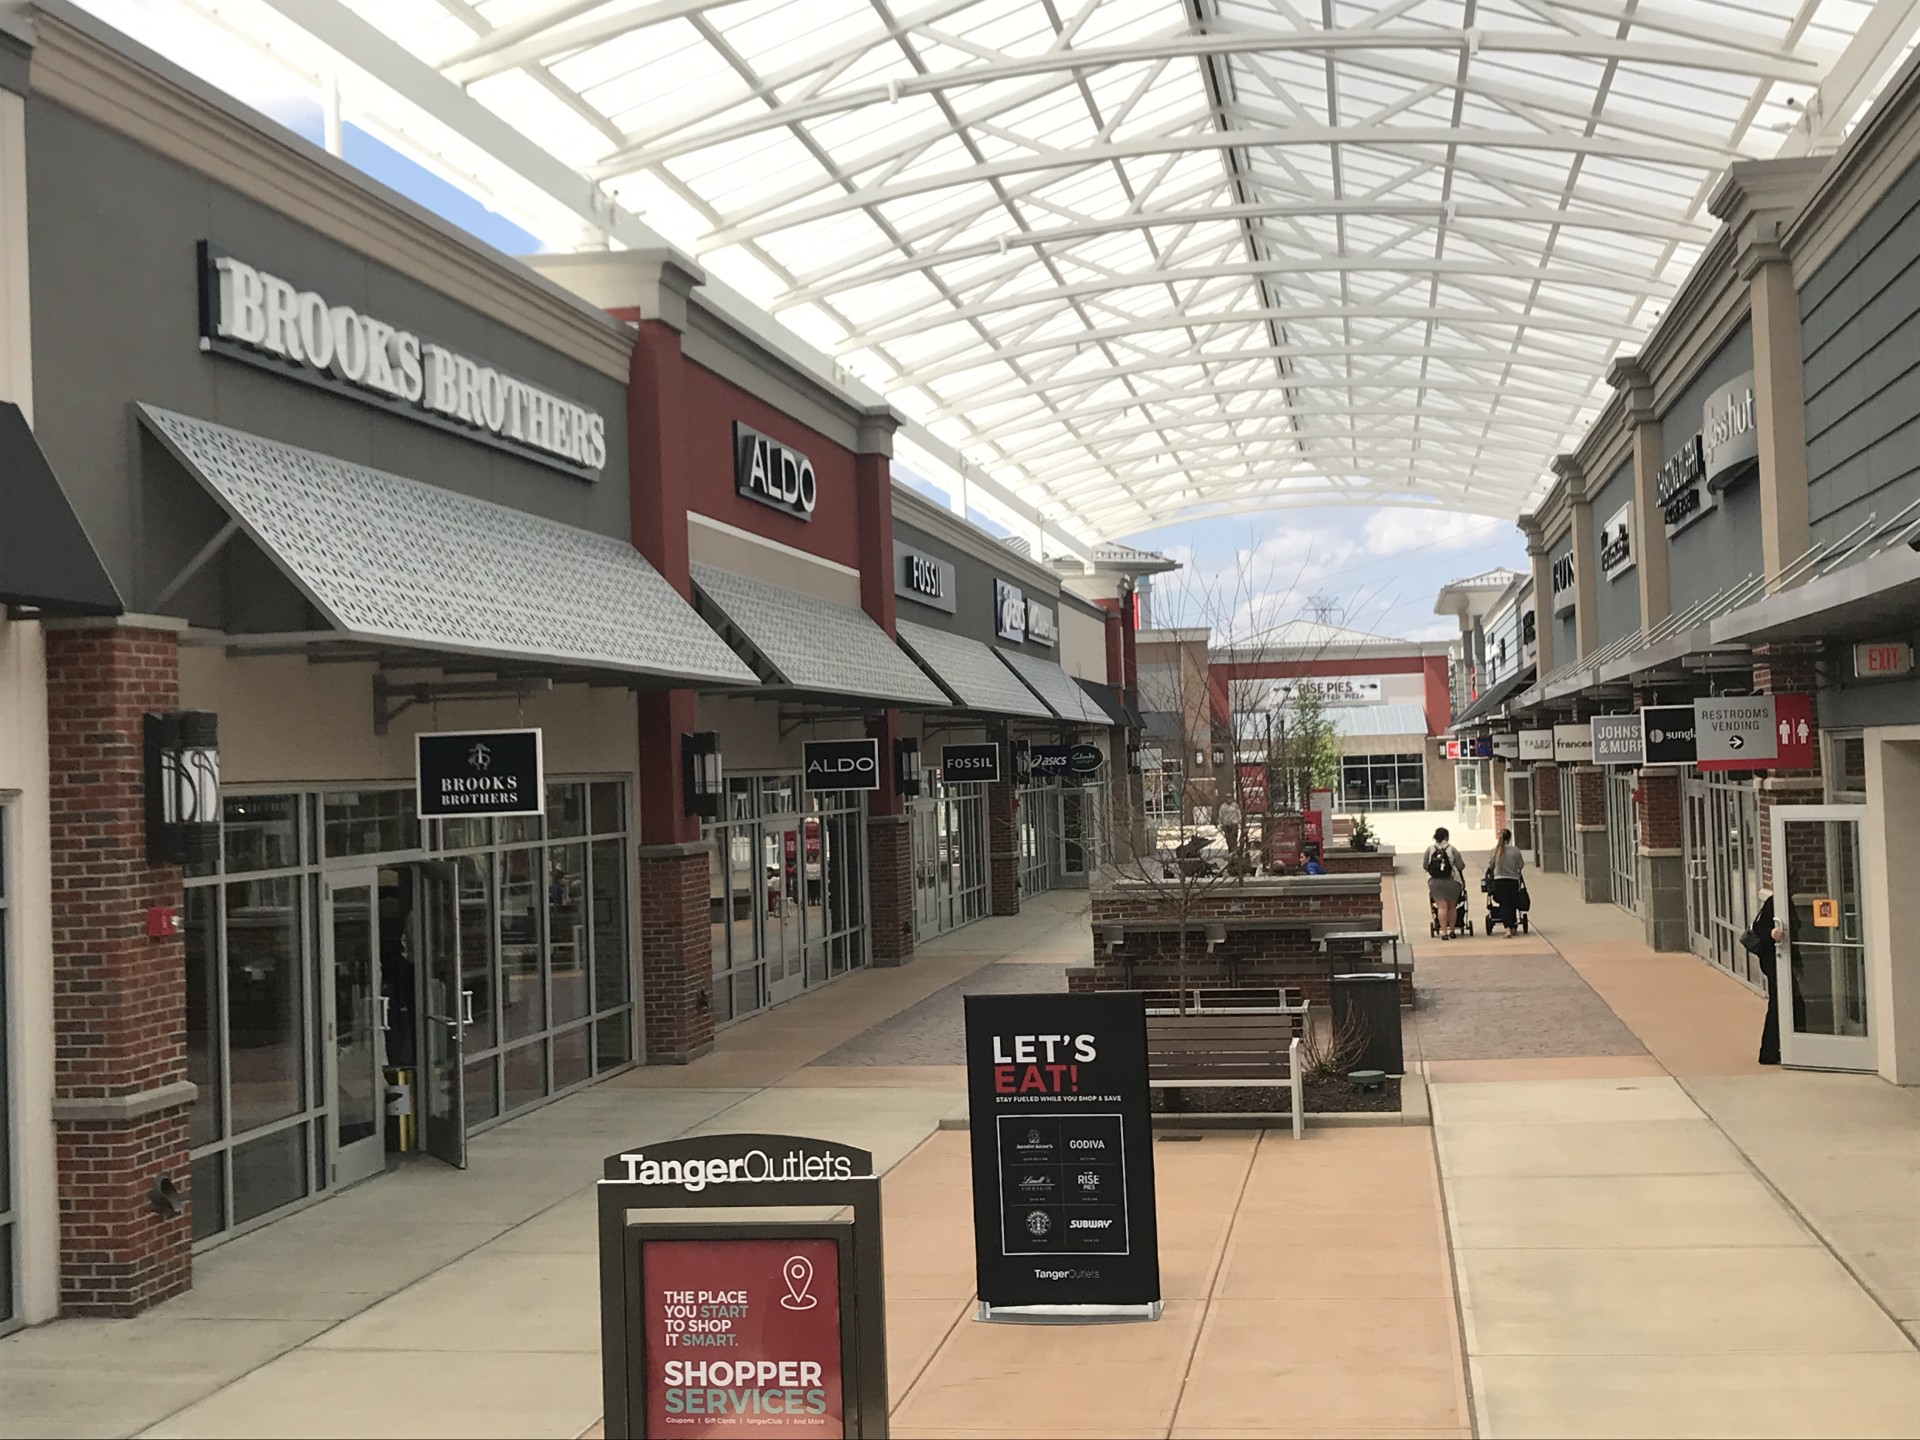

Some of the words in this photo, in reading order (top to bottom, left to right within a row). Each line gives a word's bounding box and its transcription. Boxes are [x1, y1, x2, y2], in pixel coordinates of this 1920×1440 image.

[215, 257, 423, 401] BROOKS
[423, 343, 606, 469] BROTHERS
[749, 434, 817, 513] ALDO
[911, 555, 944, 599] FOSSIL
[1868, 646, 1899, 671] EXIT
[1298, 682, 1324, 695] RISE
[1327, 681, 1353, 693] PIES
[1701, 708, 1769, 720] RESTROOMS
[1597, 725, 1642, 740] JOHNS
[1711, 721, 1760, 732] VENDING
[807, 757, 874, 772] ALDO
[947, 757, 993, 769] FOSSIL
[441, 775, 518, 792] BROOKS
[441, 792, 518, 805] BROTHERS
[993, 1034, 1097, 1064] LET'S
[994, 1064, 1079, 1094] EAT!
[1069, 1139, 1105, 1149] GODIVA
[620, 1150, 852, 1192] TangerOutlets
[1078, 1174, 1100, 1185] RISE
[1069, 1219, 1113, 1229] SUBWAY
[664, 1291, 694, 1304] THE
[698, 1290, 748, 1304] PLACE
[664, 1305, 697, 1318] YOU
[700, 1305, 749, 1318] START
[665, 1320, 685, 1332] TO
[688, 1320, 732, 1332] SHOP
[666, 1334, 679, 1346] IT
[682, 1333, 739, 1346] SMART.
[664, 1360, 822, 1387] SHOPPER
[665, 1388, 827, 1415] SERVICES
[666, 1416, 695, 1425] Coupons
